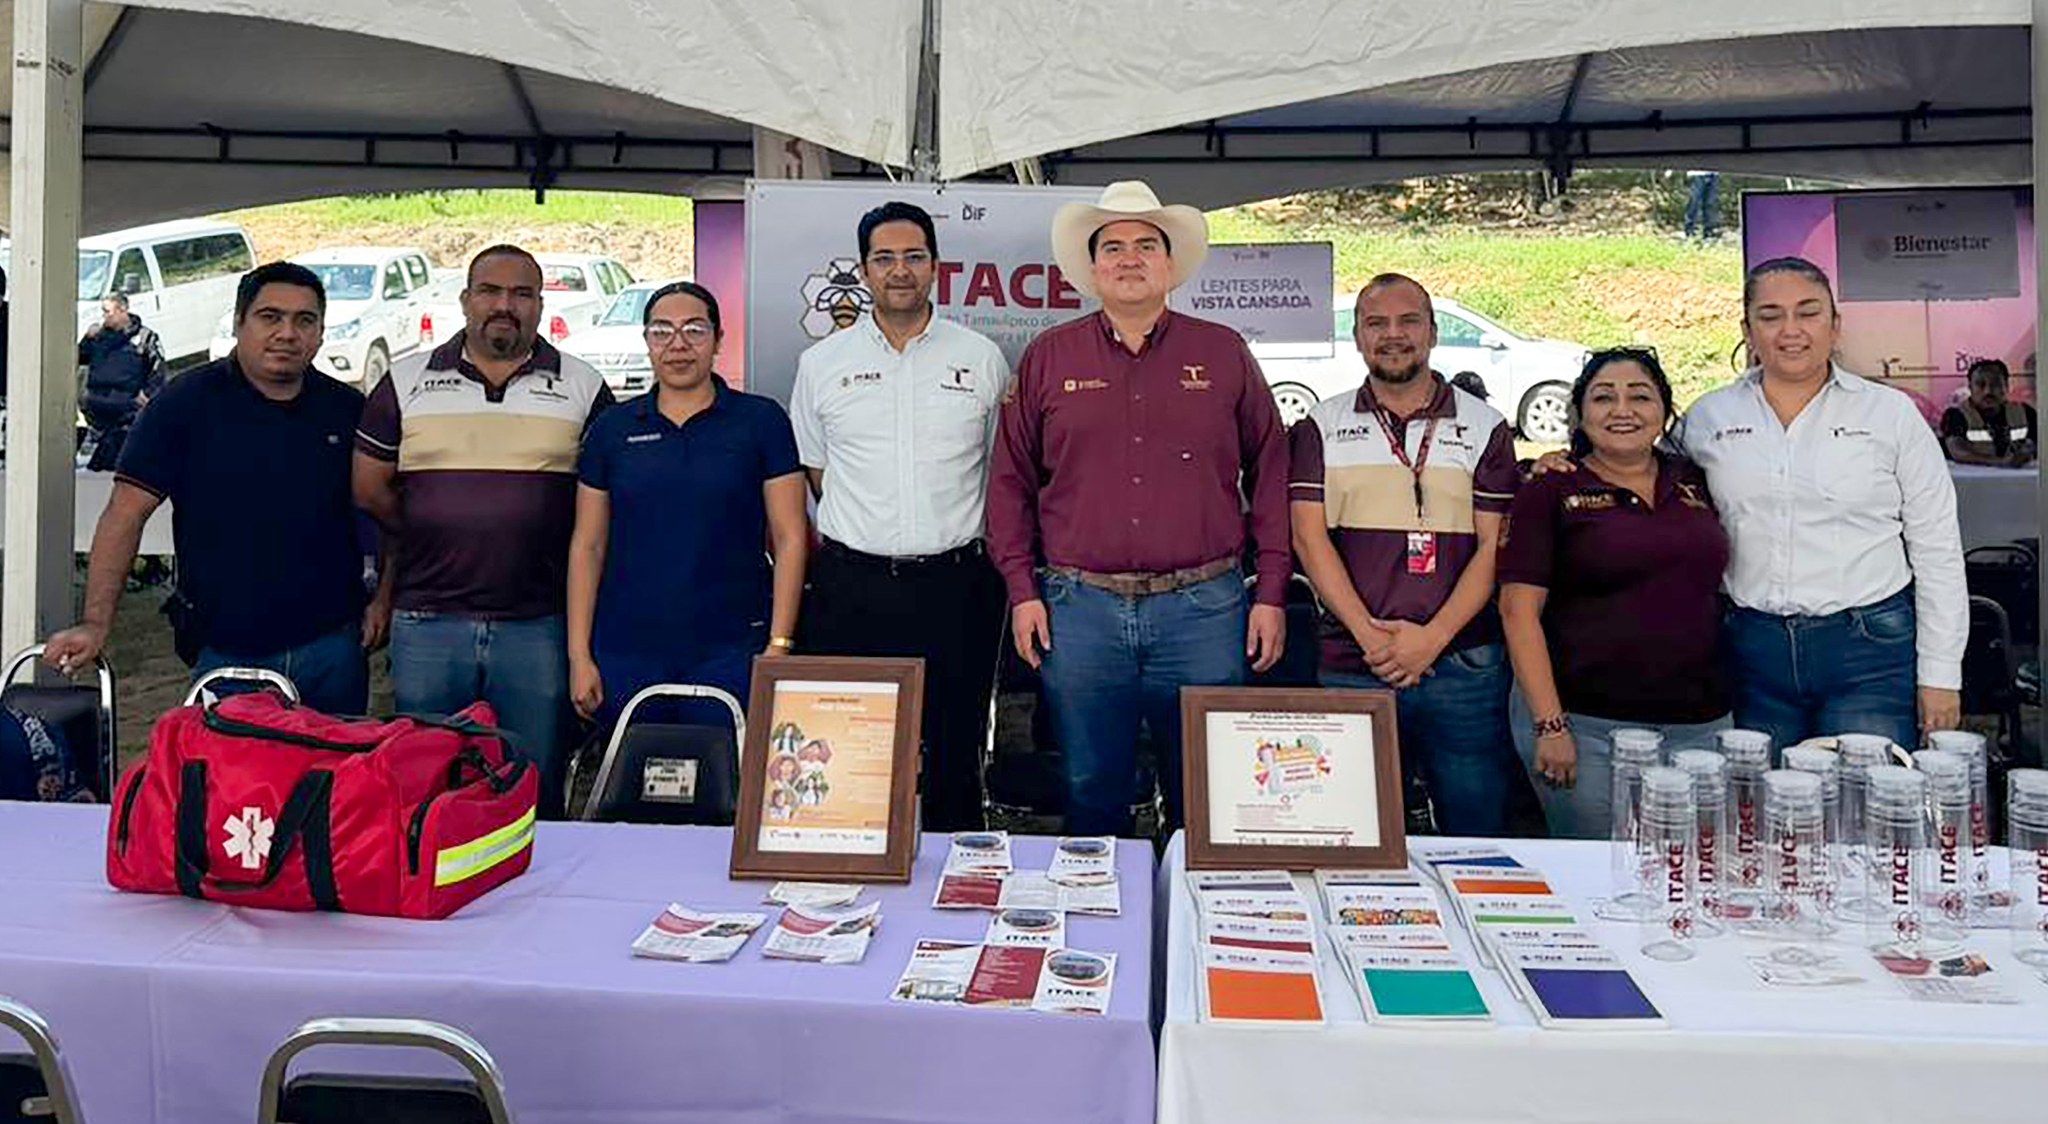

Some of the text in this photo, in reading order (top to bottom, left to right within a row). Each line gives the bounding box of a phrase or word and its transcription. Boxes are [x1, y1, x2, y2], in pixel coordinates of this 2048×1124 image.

[1894, 234, 1992, 253] Bienestar
[937, 262, 1082, 309] TACE
[1201, 277, 1302, 294] LENTES PARA
[1191, 295, 1312, 310] VISTA CANSADA
[1940, 824, 1957, 884] ITACE
[1668, 842, 1684, 903] ITACE
[1892, 842, 1909, 905] ITACE
[1048, 987, 1098, 996] ITACE
